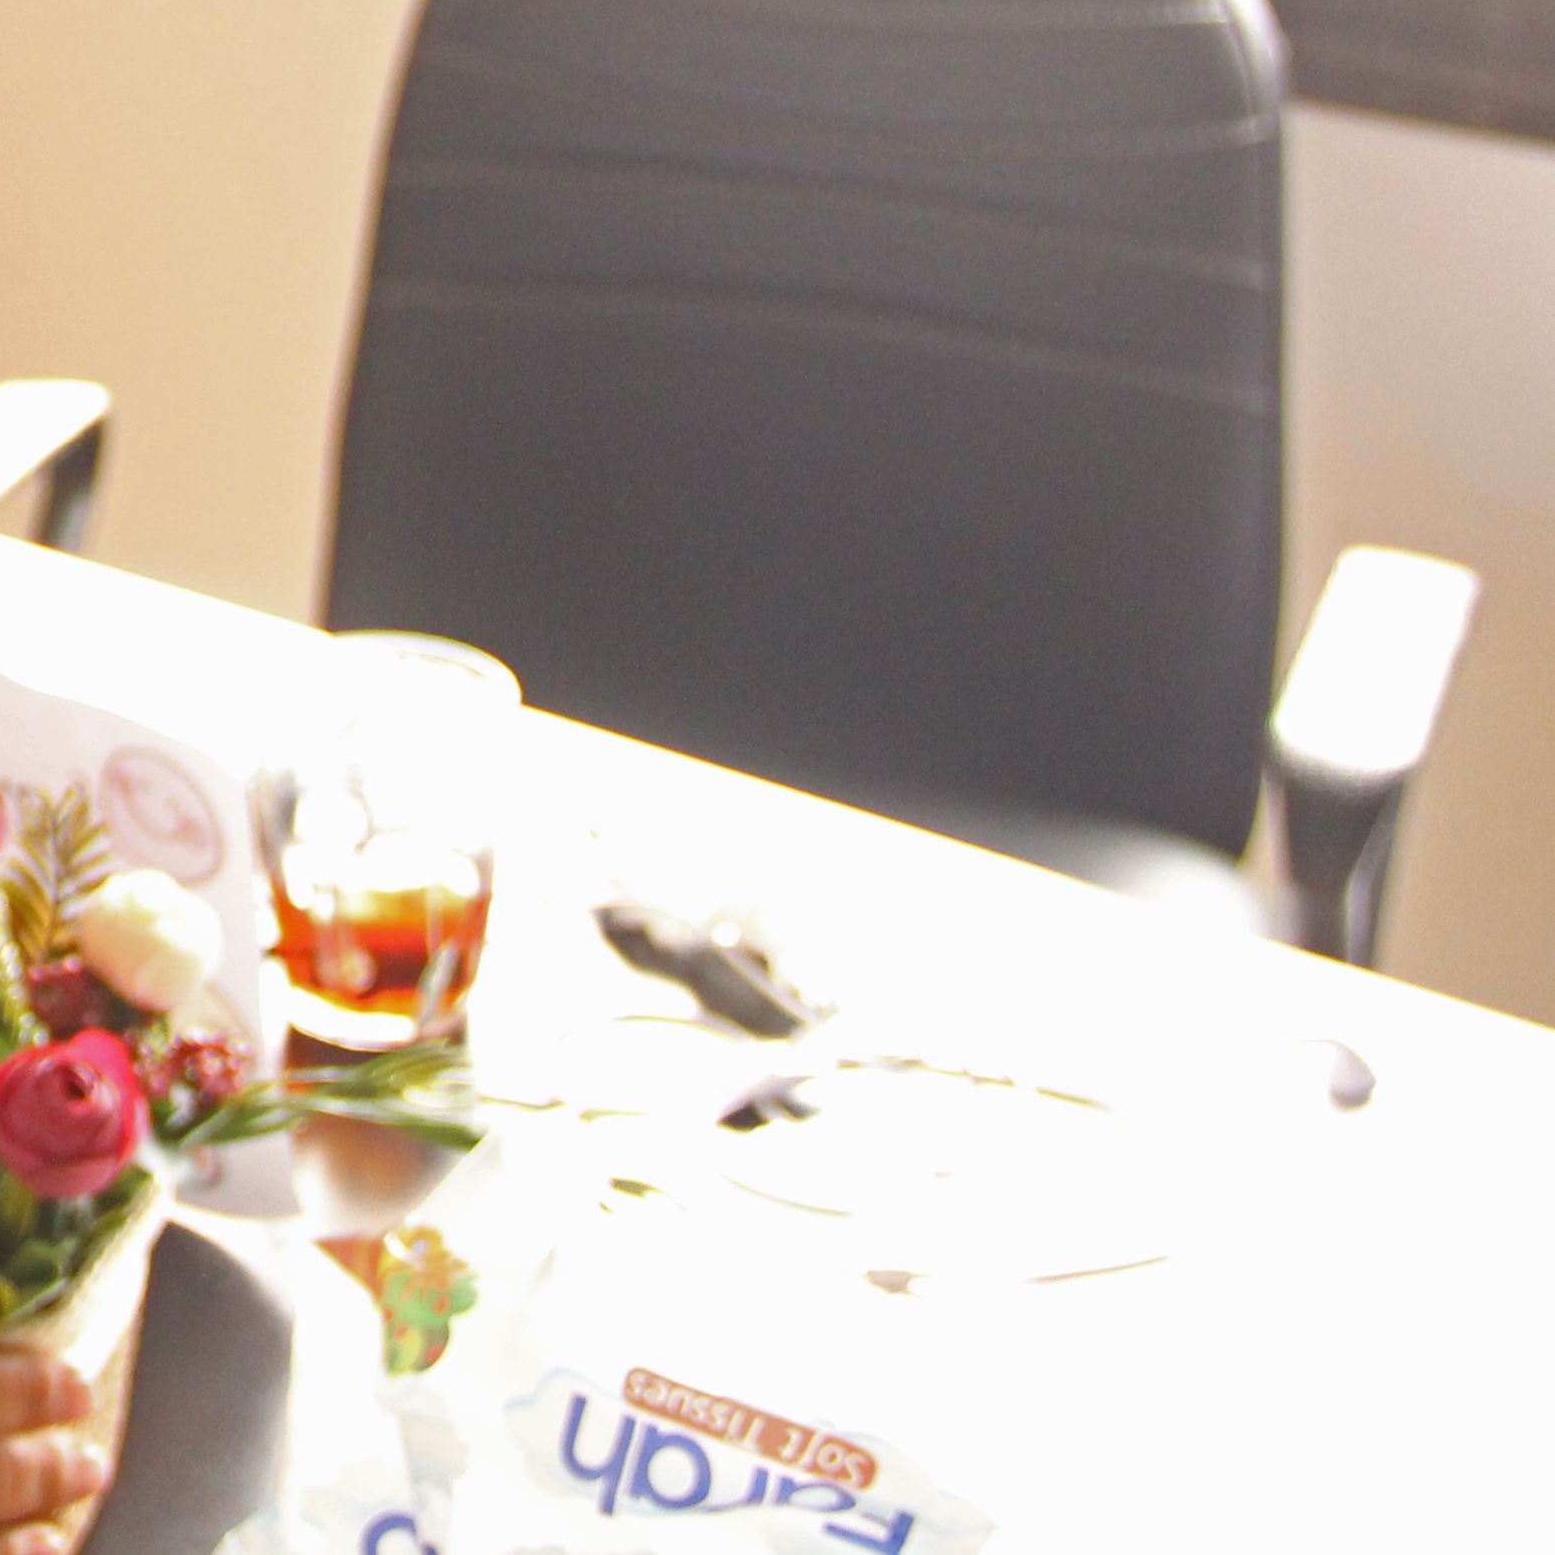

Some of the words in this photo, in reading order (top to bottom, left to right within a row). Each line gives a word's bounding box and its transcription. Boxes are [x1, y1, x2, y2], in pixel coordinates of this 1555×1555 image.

[625, 1367, 768, 1450] Tissues
[561, 1393, 915, 1555] Farah
[779, 1427, 870, 1488] Soft
